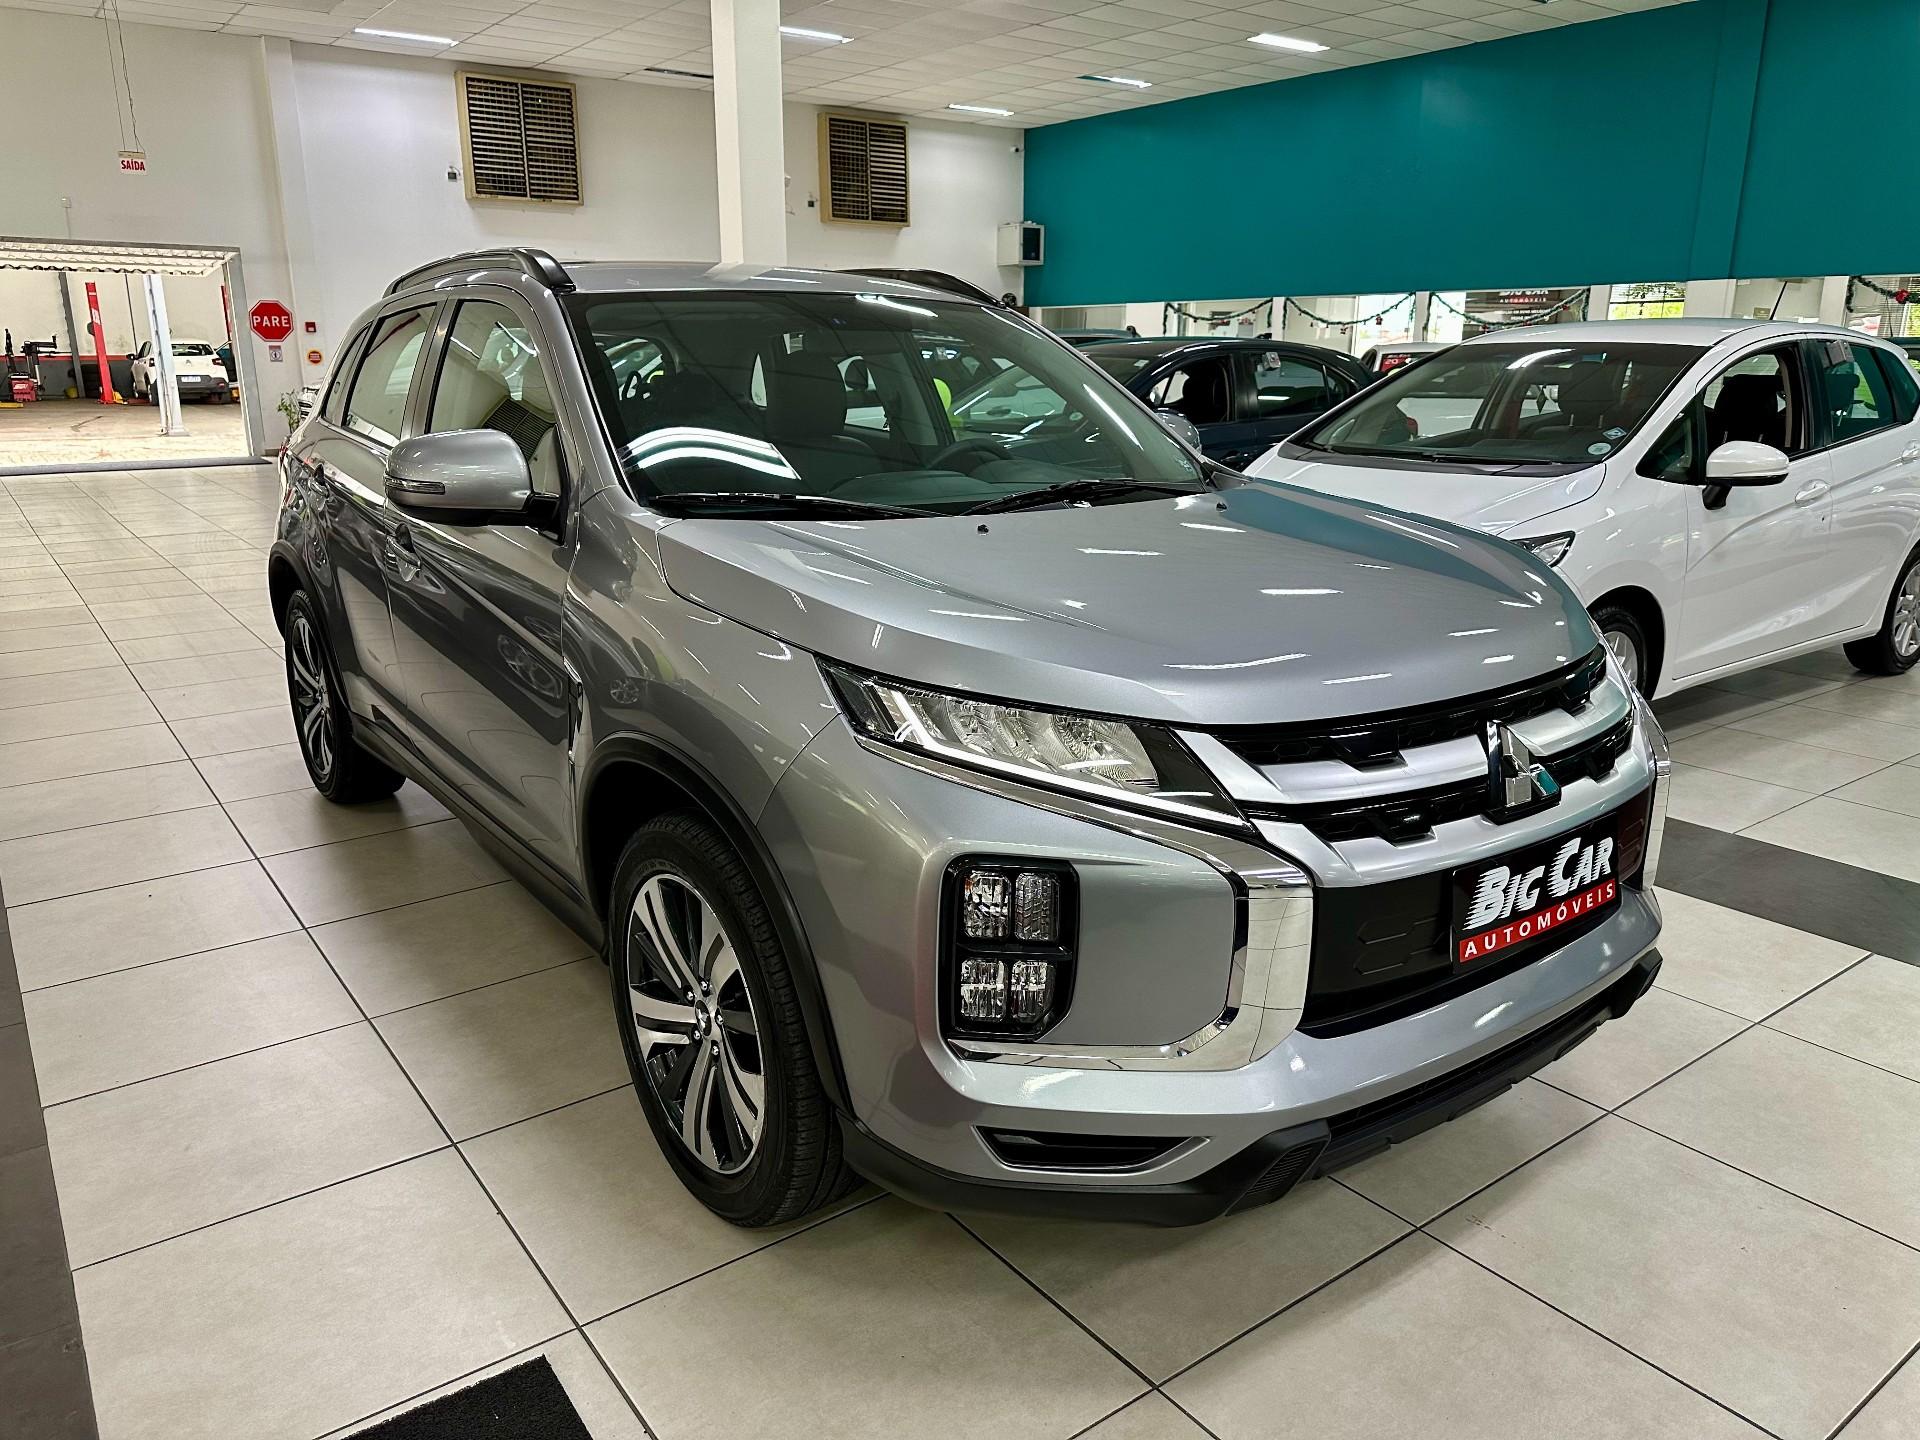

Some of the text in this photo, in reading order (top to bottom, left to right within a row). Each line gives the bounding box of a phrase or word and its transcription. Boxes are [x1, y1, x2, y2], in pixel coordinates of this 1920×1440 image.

[121, 159, 145, 171] SAÍDA
[253, 315, 290, 327] PARE
[1462, 836, 1614, 931] BIG CAR
[1464, 883, 1614, 958] AUTOMÓVEIS
